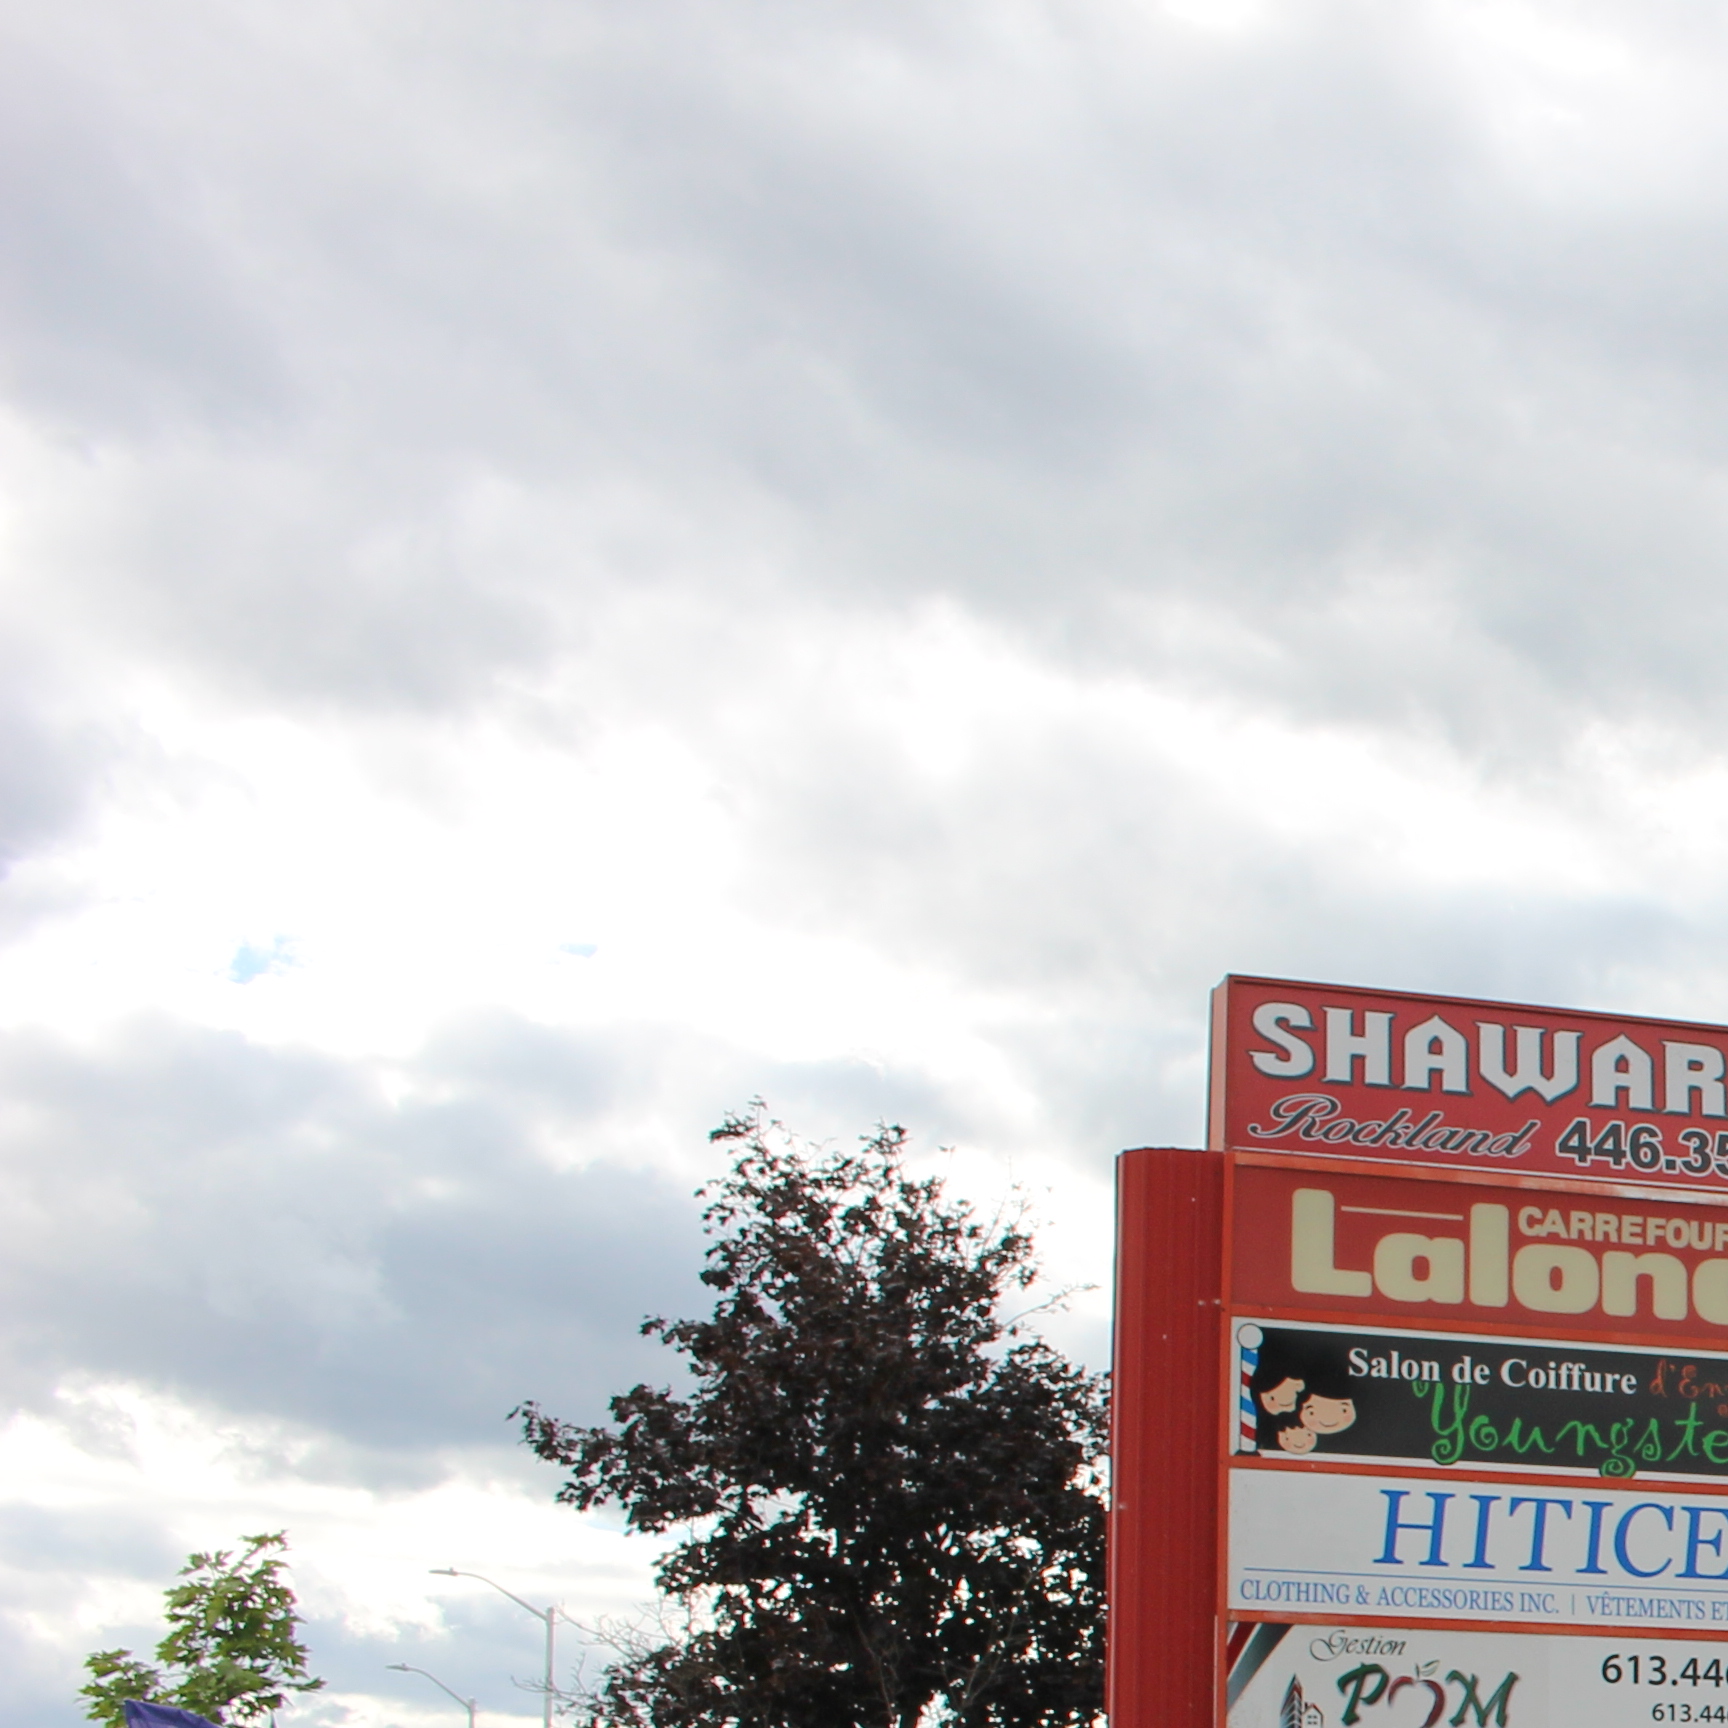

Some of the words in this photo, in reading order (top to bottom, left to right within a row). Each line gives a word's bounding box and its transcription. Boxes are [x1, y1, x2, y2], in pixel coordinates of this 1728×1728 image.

[1248, 1093, 1541, 1159] Rockland
[1348, 1348, 1443, 1384] Salon
[1451, 1355, 1493, 1388] de
[1500, 1358, 1638, 1397] Coiffure
[1239, 1578, 1352, 1608] CLOTHING
[1354, 1583, 1372, 1608] &
[1375, 1584, 1516, 1614] ACCESSORIES
[1519, 1590, 1561, 1615] INC.
[1586, 1588, 1707, 1622] VÊTEMENTS
[1308, 1627, 1407, 1662] Gestion
